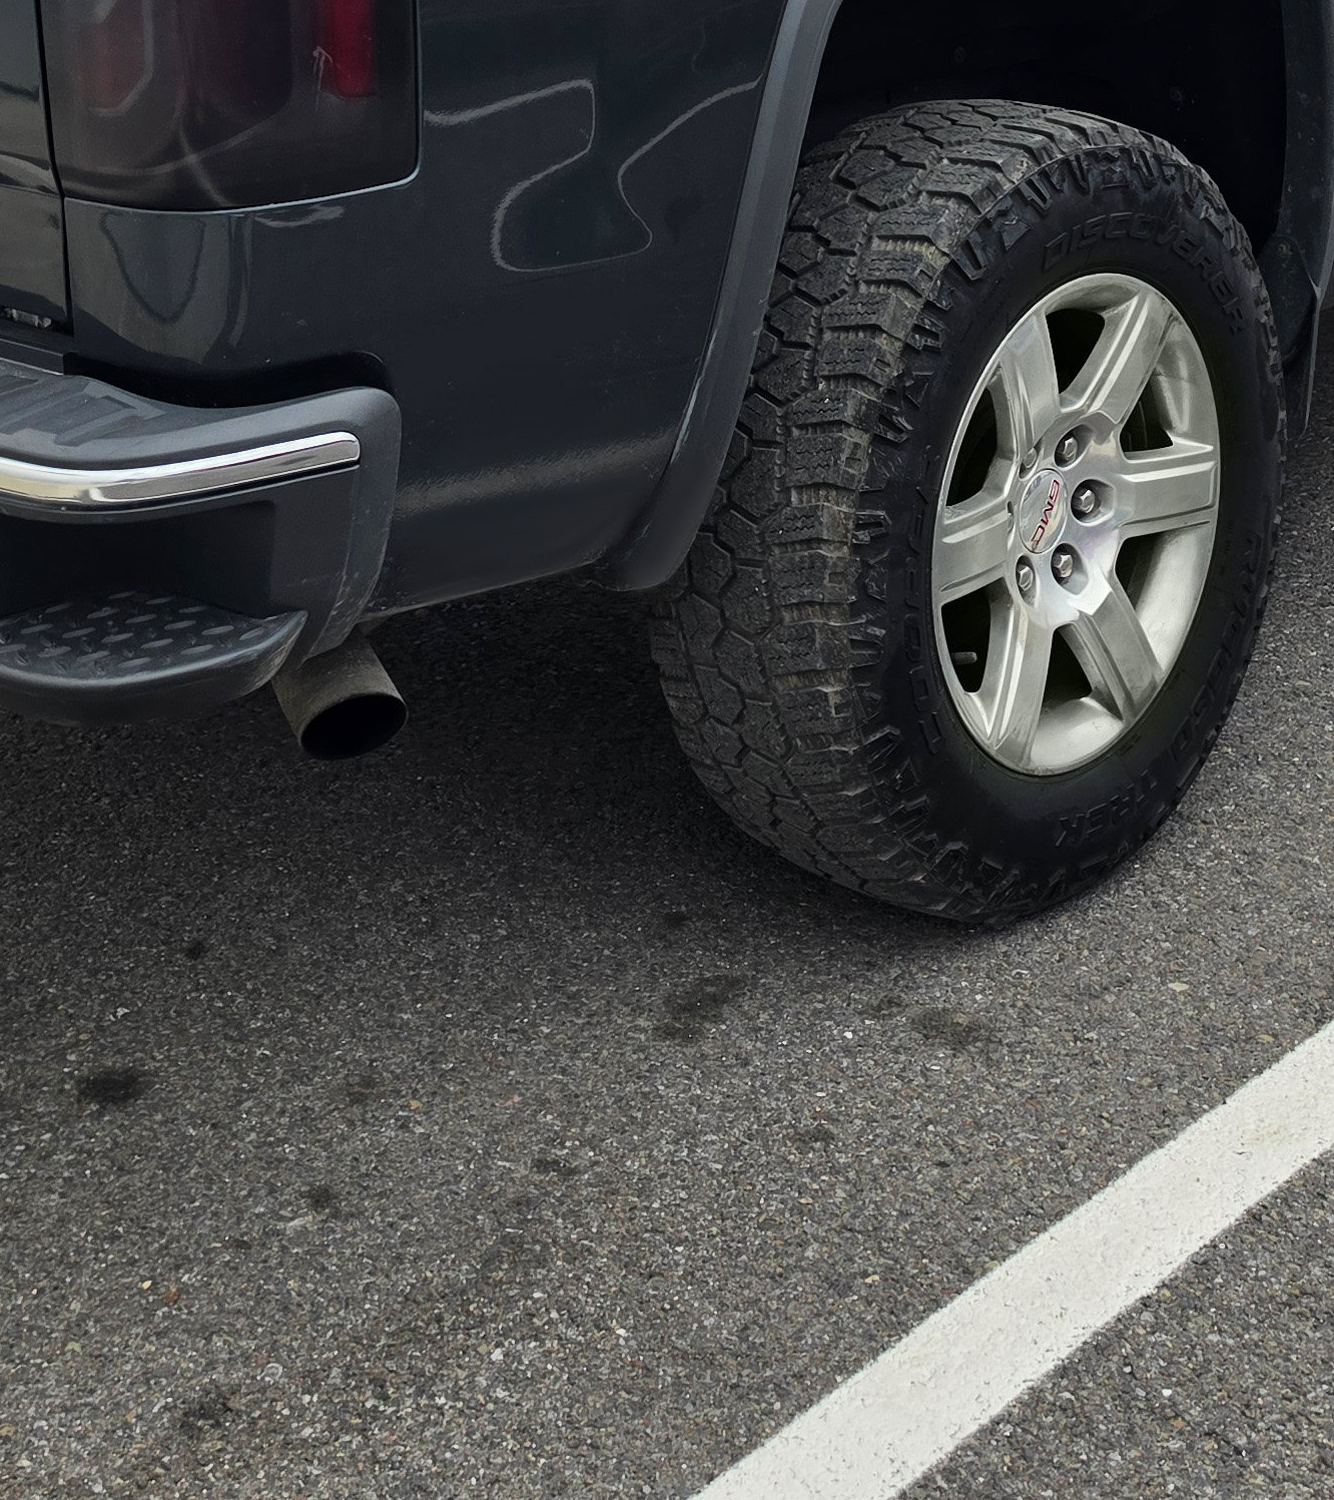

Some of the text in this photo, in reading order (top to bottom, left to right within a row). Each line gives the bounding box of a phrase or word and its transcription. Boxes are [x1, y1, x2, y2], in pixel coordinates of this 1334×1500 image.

[1042, 211, 1245, 336] DISCOVERER
[1030, 479, 1060, 552] GMC
[1055, 768, 1157, 847] TREK
